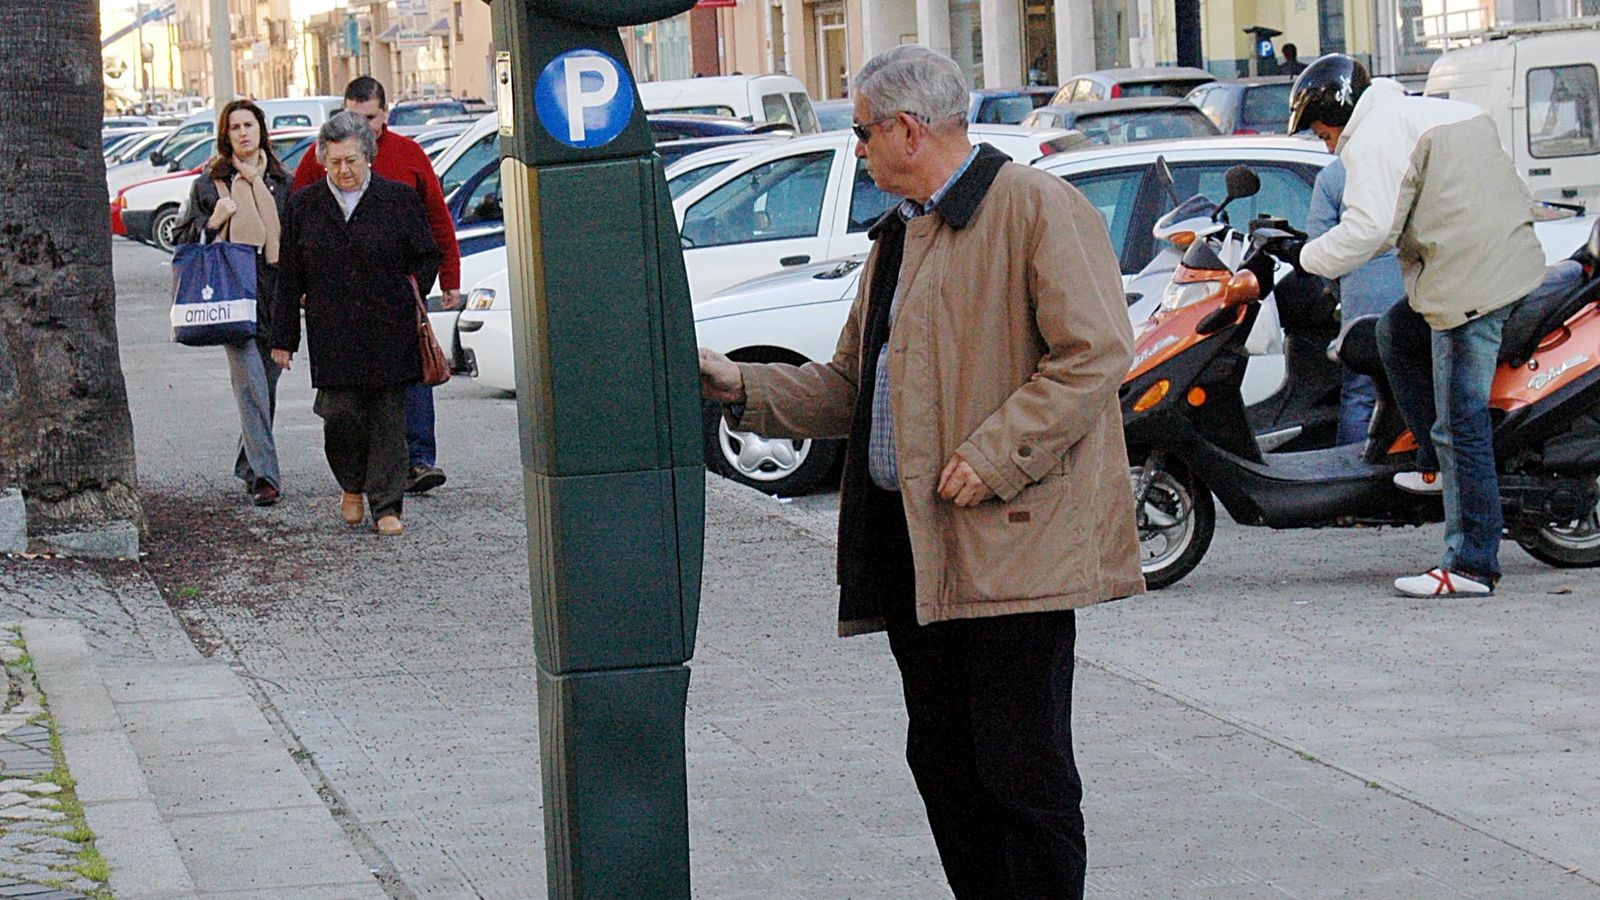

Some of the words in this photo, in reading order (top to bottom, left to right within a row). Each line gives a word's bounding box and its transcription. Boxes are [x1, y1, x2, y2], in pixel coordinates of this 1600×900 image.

[1262, 40, 1272, 57] P
[564, 56, 618, 141] P
[185, 304, 231, 323] amichi
